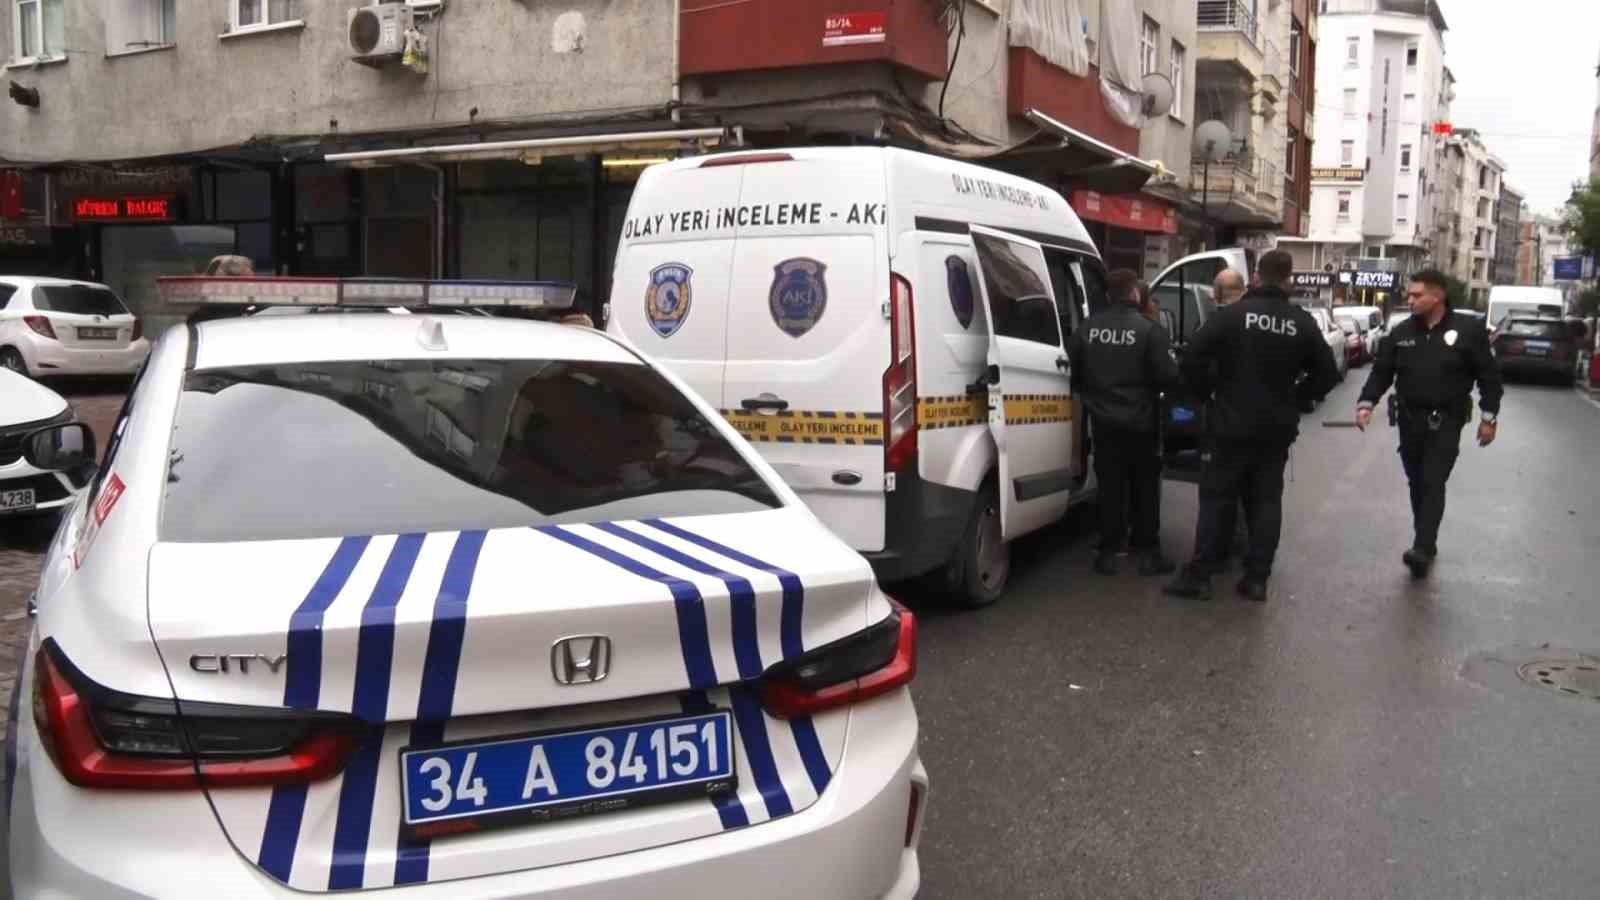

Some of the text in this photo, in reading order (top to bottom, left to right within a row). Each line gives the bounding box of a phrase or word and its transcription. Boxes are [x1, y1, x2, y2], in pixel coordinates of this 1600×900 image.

[625, 213, 664, 239] OLAY
[780, 422, 803, 433] OLAY
[189, 653, 287, 674] CITY
[419, 721, 717, 813] 34 A 84151
